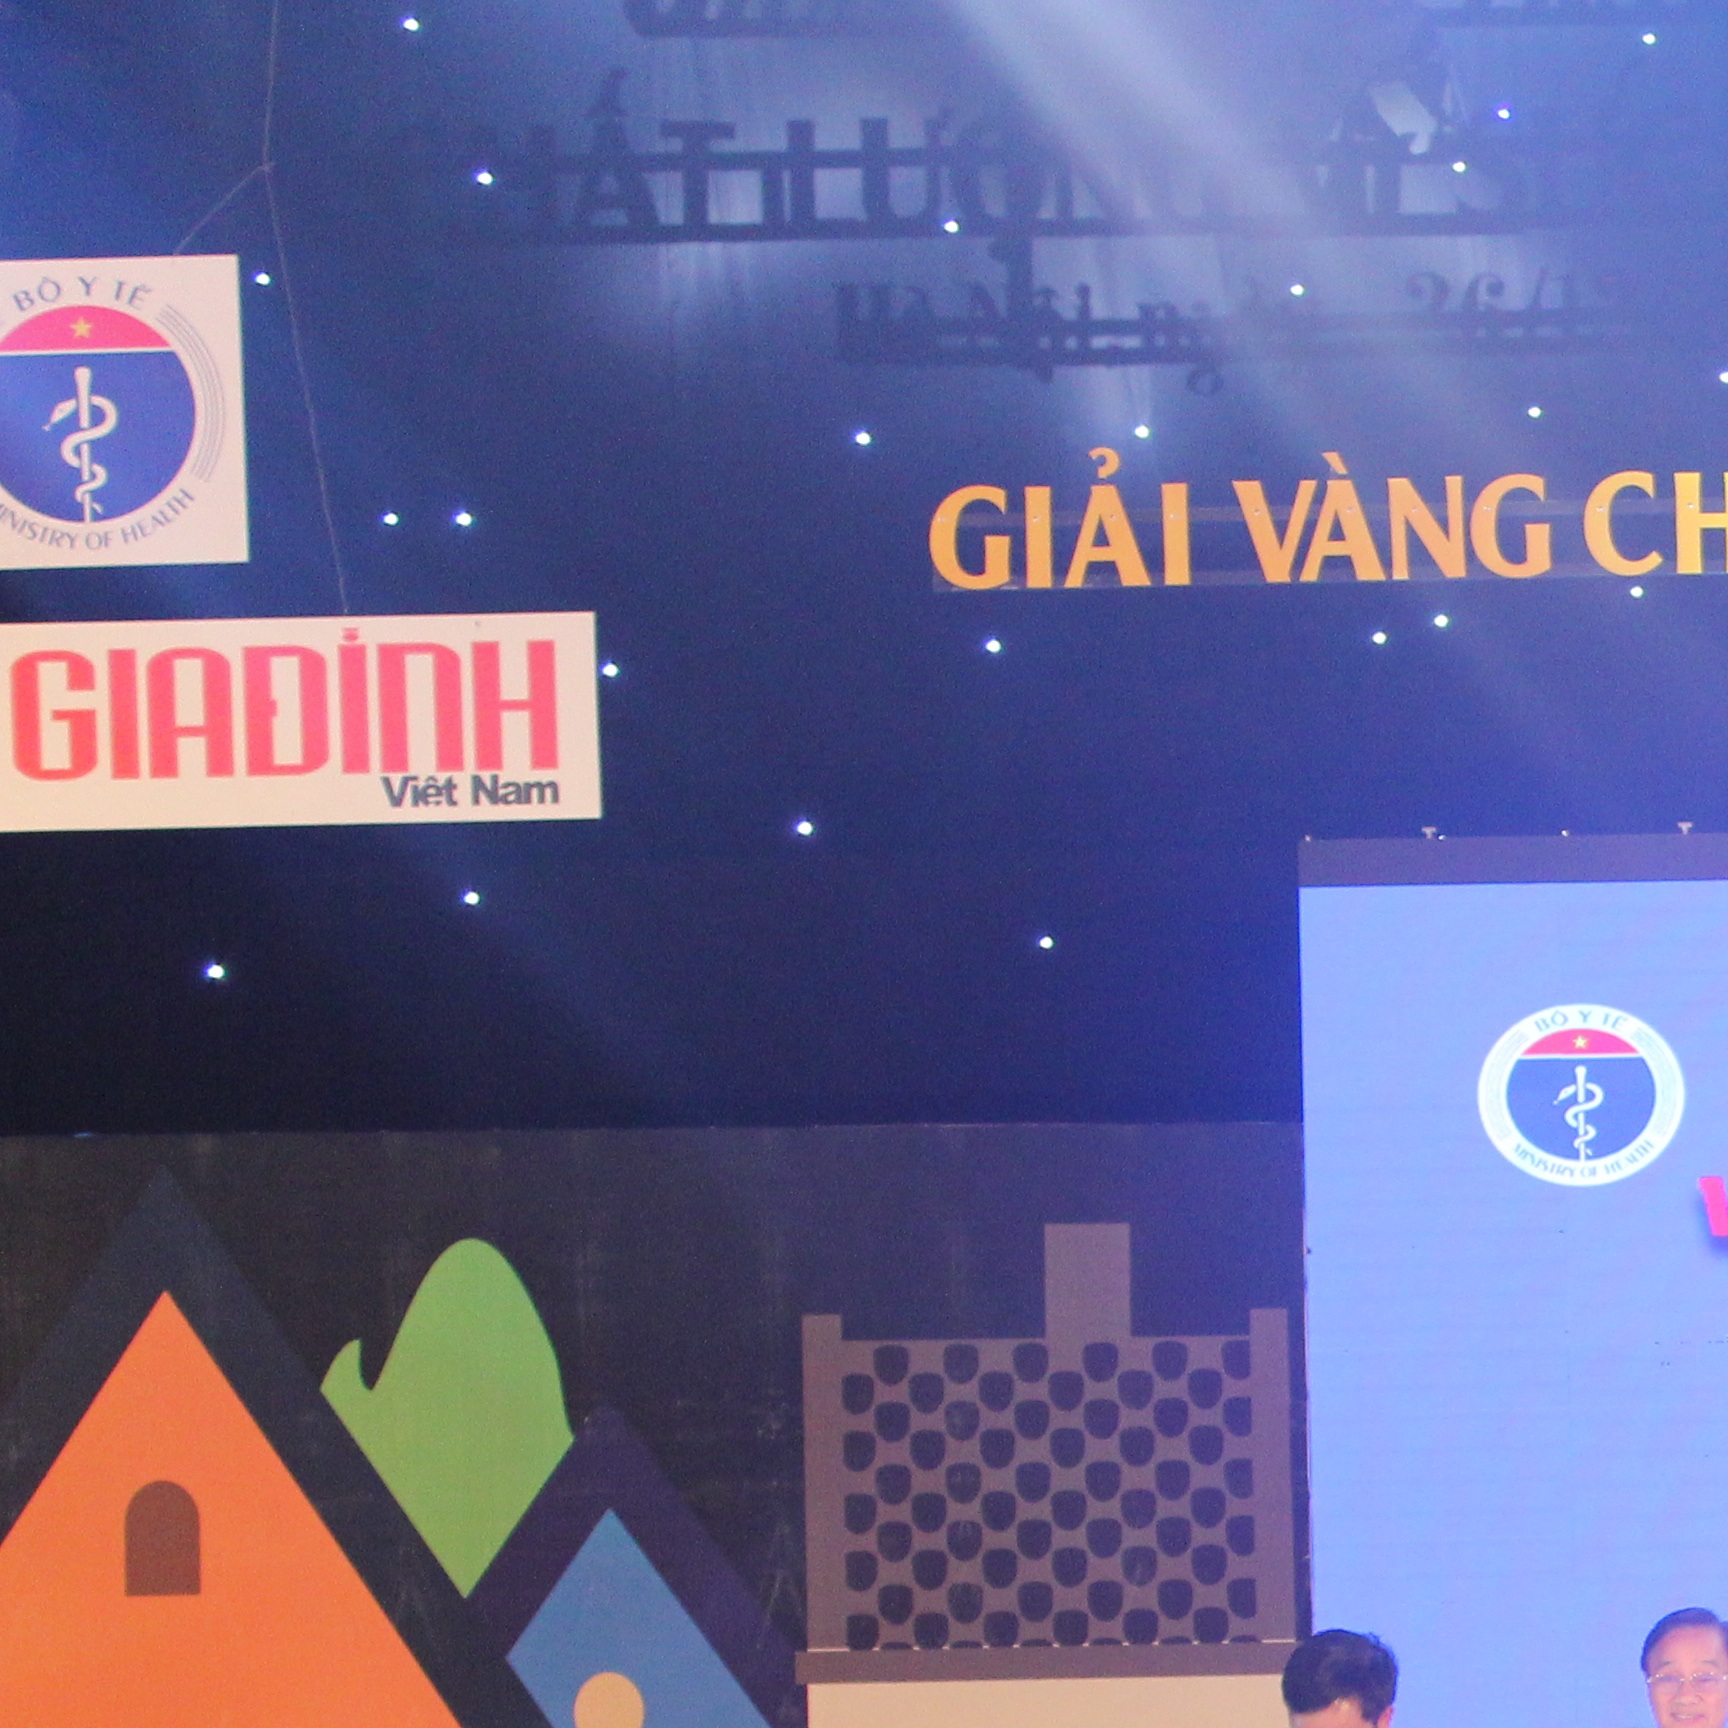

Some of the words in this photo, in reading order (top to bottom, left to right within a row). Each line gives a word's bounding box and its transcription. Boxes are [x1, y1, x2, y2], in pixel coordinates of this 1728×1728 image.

[77, 275, 98, 297] Y
[85, 530, 114, 550] OF
[120, 491, 195, 544] HEALTH
[929, 446, 1191, 590] GIẢI
[1233, 453, 1552, 583] VÀNG
[381, 773, 458, 808] Việt
[470, 773, 560, 806] Nam
[1578, 1009, 1592, 1024] Y
